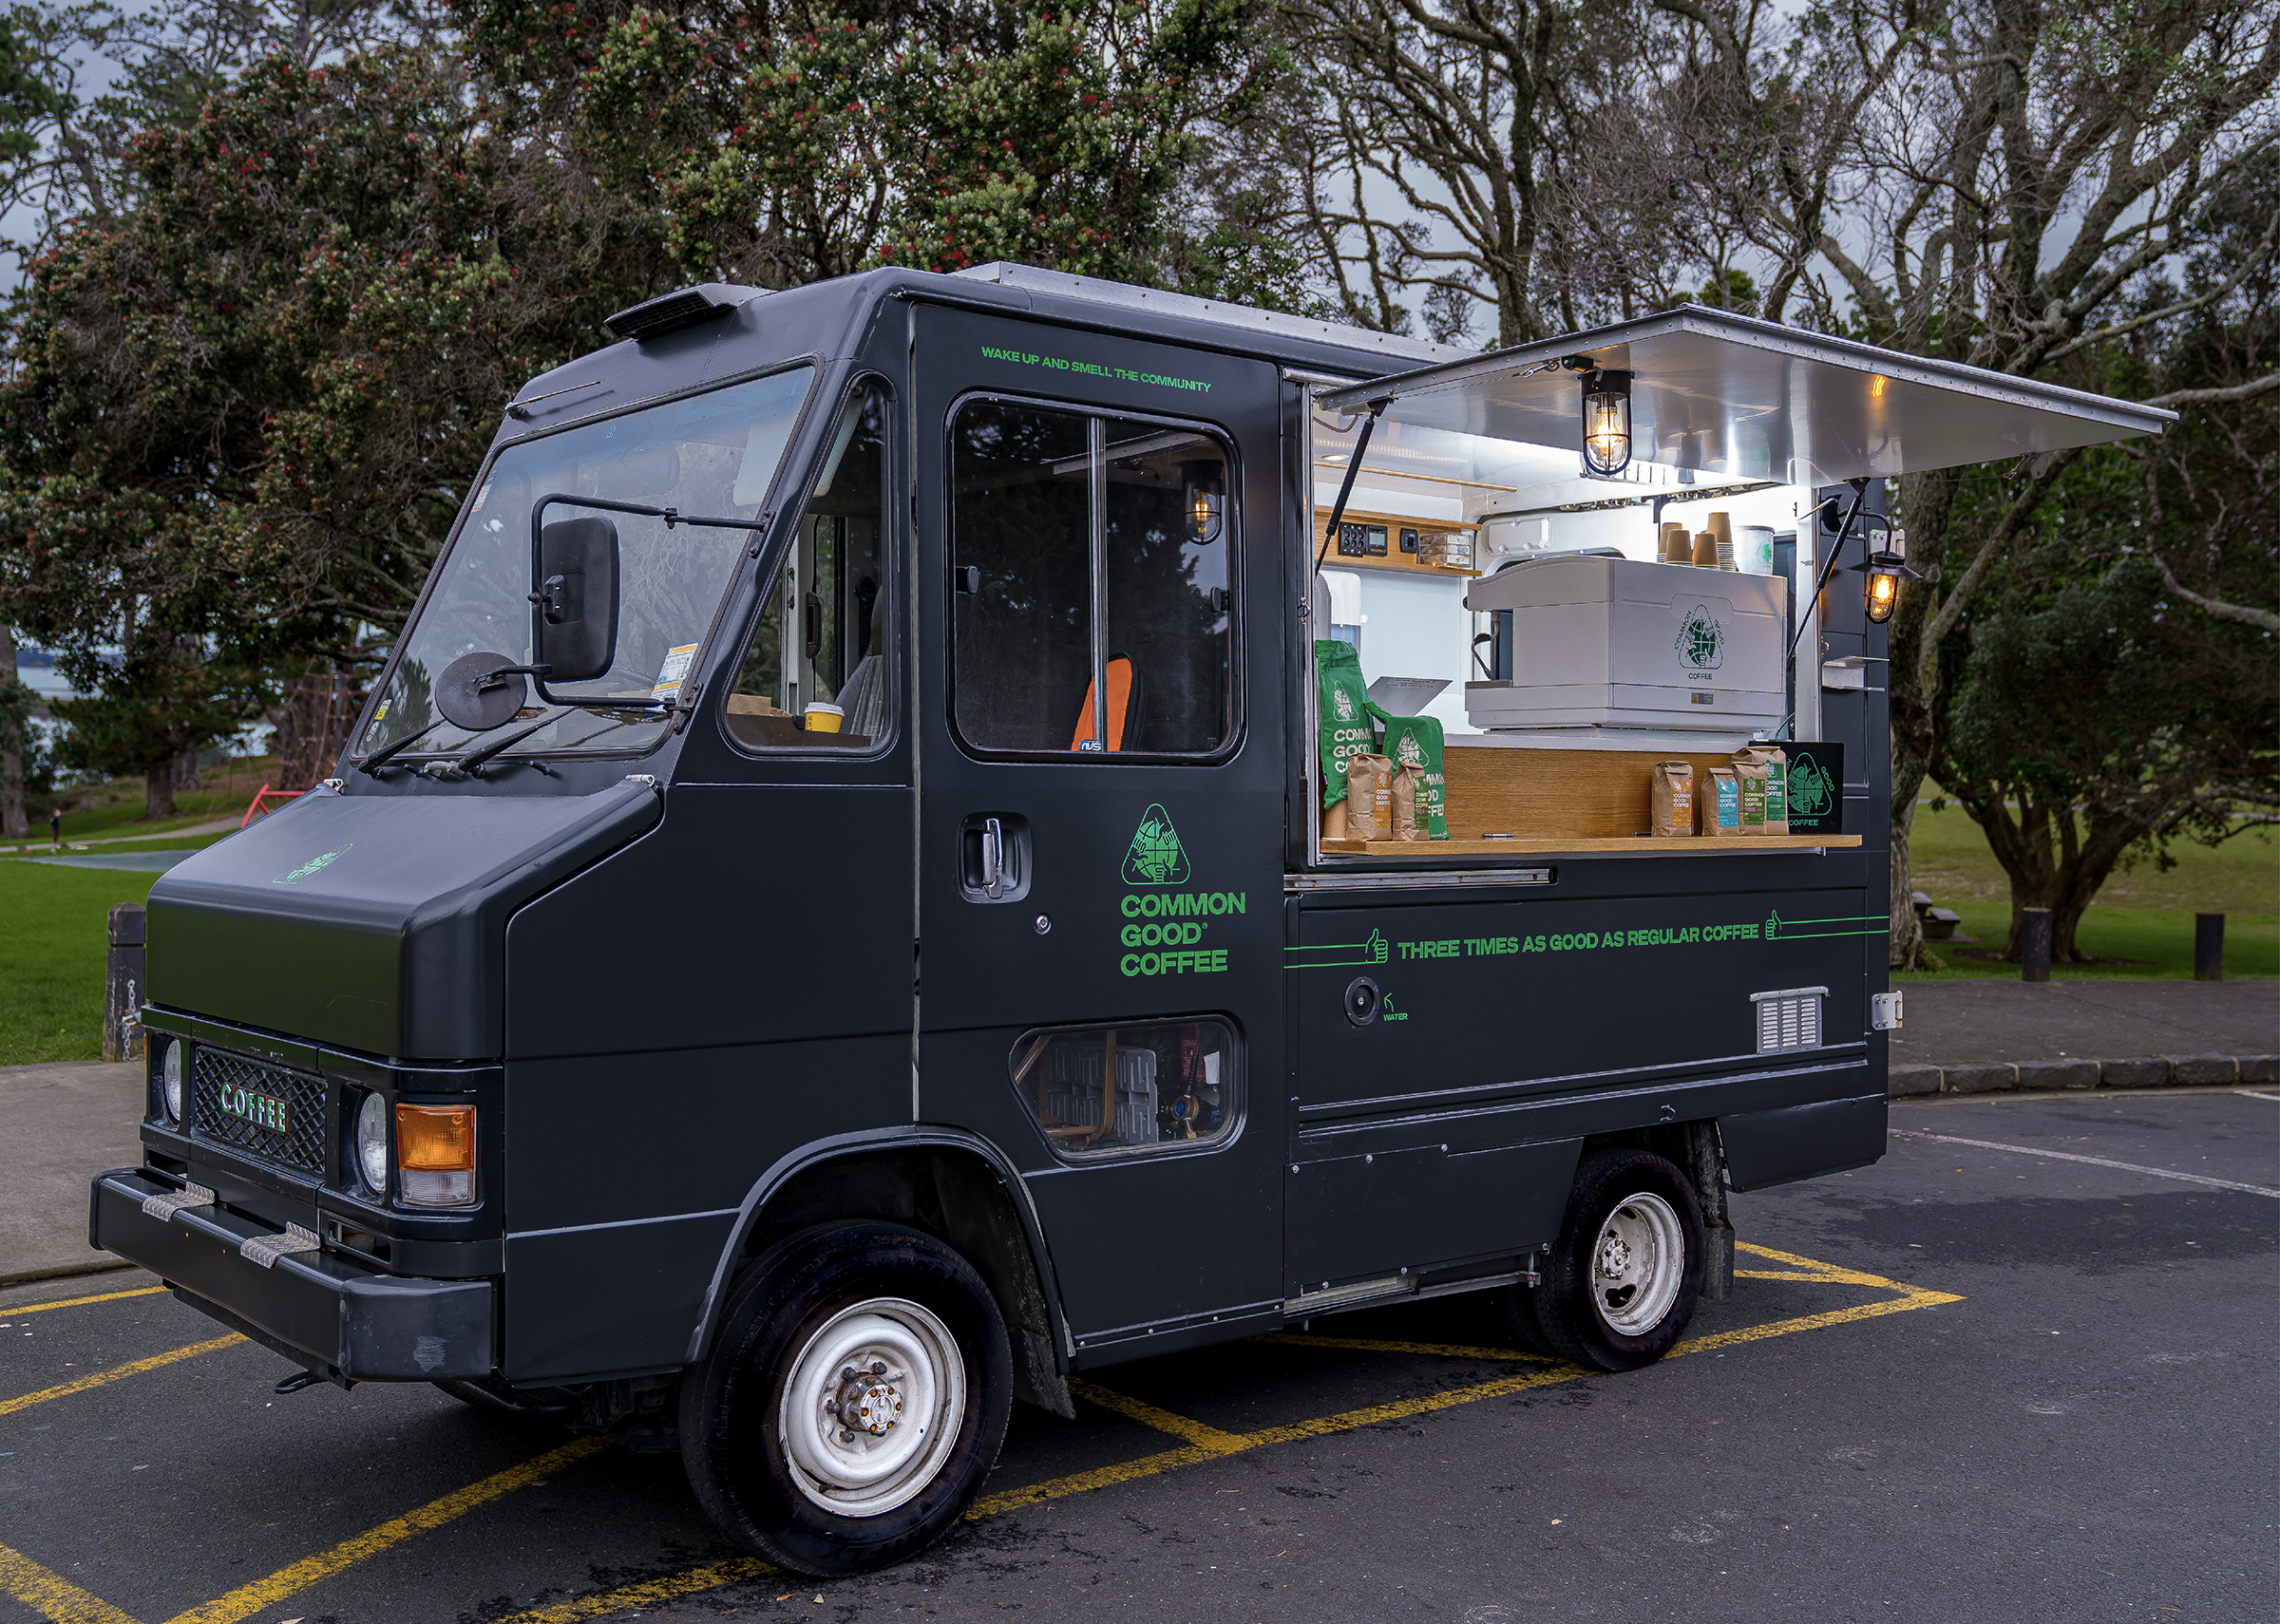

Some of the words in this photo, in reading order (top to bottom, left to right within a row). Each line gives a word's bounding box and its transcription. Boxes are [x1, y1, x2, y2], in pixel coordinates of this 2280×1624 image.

[981, 347, 1019, 362] WAKE
[1022, 353, 1039, 365] UP
[1042, 357, 1069, 369] AND
[1072, 361, 1112, 377] SMELL
[1114, 368, 1138, 381] THE
[1141, 373, 1211, 392] COMMUNITY
[1675, 611, 1692, 650] COMMON
[1714, 619, 1725, 645] GOOD
[1820, 765, 1835, 792] GOOD
[1788, 819, 1819, 827] COFFEE
[1121, 892, 1246, 918] COMMON
[1397, 939, 1460, 959] THREE
[1464, 936, 1519, 955] TIMES
[1522, 935, 1547, 953] AS
[1549, 933, 1599, 951] GOOD
[1602, 931, 1624, 948] AS
[1627, 927, 1700, 946] REGULAR
[1702, 924, 1758, 941] COFFEE
[1120, 950, 1228, 976] COFFEE
[1383, 1012, 1409, 1022] WATER
[220, 1084, 286, 1132] COFFEE
